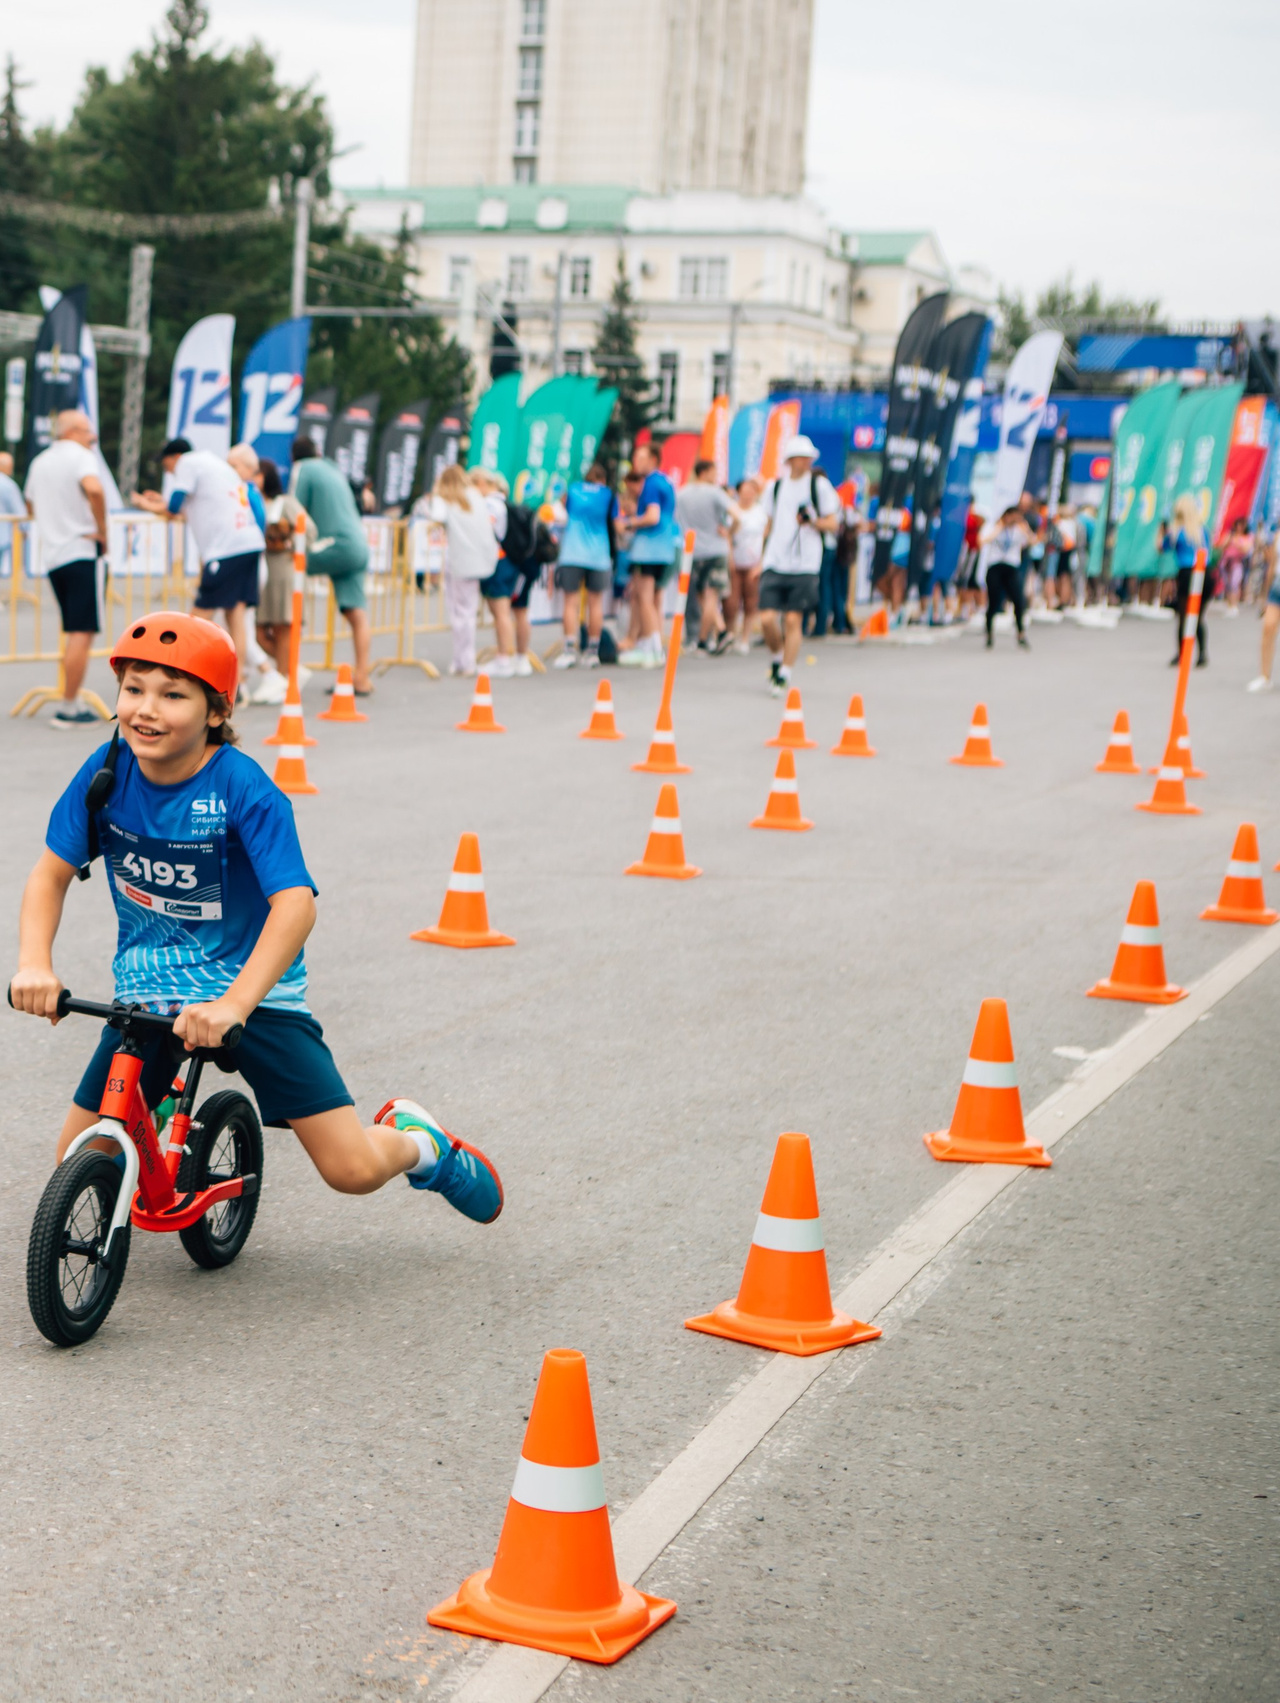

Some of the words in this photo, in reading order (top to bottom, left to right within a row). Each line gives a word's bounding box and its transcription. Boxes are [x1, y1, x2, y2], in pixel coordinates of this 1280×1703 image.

[178, 366, 230, 438] 12
[242, 371, 302, 444] 12
[122, 852, 197, 889] 4193
